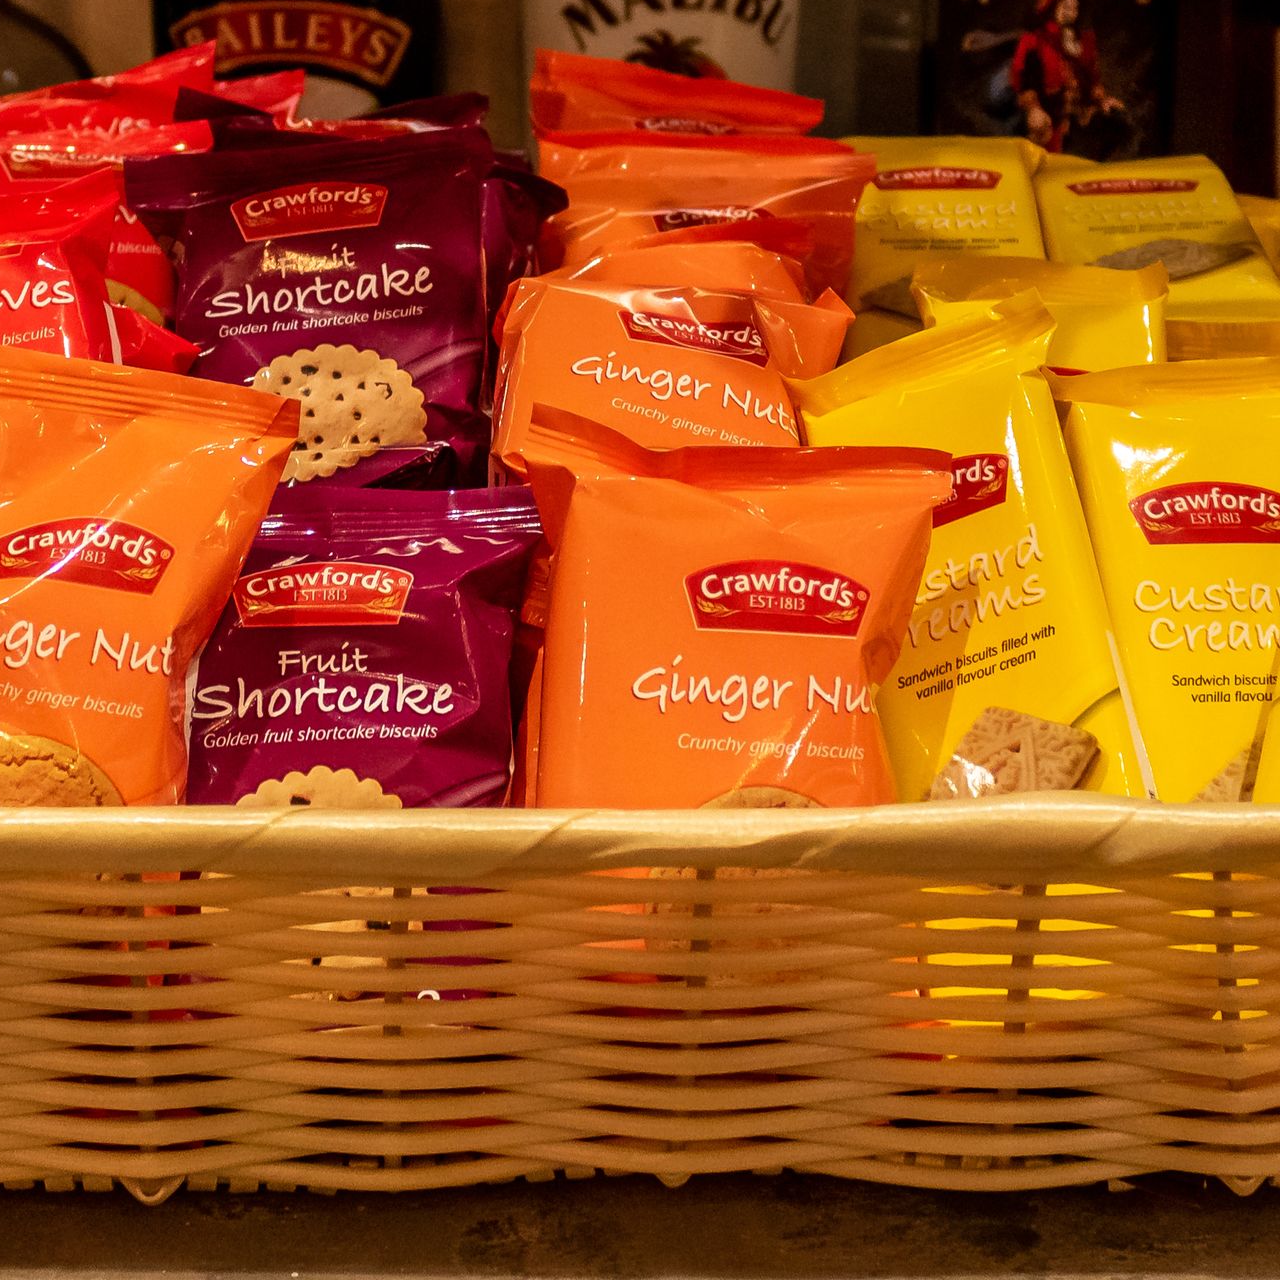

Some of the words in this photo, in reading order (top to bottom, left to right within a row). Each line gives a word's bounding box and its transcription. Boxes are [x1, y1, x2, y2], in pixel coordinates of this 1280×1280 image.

[245, 186, 373, 218] Crawford's
[205, 263, 434, 319] Shortcake
[1, 325, 56, 347] biscuits
[218, 323, 269, 339] Golden
[271, 318, 300, 333] fruit
[301, 312, 370, 330] shortcake
[372, 304, 424, 322] biscuits
[632, 312, 762, 347] Crawford's
[571, 351, 712, 400] Ginger
[611, 397, 670, 424] Crunchy
[672, 416, 718, 438] ginger
[6, 523, 157, 566] Crawford's
[915, 523, 1045, 605] stard
[245, 567, 395, 597] Crawford's
[700, 567, 855, 609] Crawford's
[278, 642, 369, 675] Fruit
[898, 661, 953, 690] Sandwich
[955, 646, 998, 670] biscuits
[1001, 634, 1028, 654] filled
[1031, 624, 1056, 642] with
[916, 677, 954, 700] vanilla
[957, 663, 998, 687] flavour
[999, 649, 1037, 671] cream
[192, 673, 455, 719] Shortcake
[631, 654, 793, 723] Ginger
[1172, 674, 1230, 687] Sandwich
[1191, 691, 1231, 703] vanilla
[26, 688, 80, 712] ginger
[82, 697, 145, 719] biscuits
[204, 732, 258, 749] Golden
[263, 726, 293, 744] fruit
[297, 725, 376, 742] shortcake
[379, 724, 439, 739] biscuits
[677, 732, 747, 755] Crunchy
[749, 738, 802, 758] ginger
[806, 740, 865, 761] biscuits
